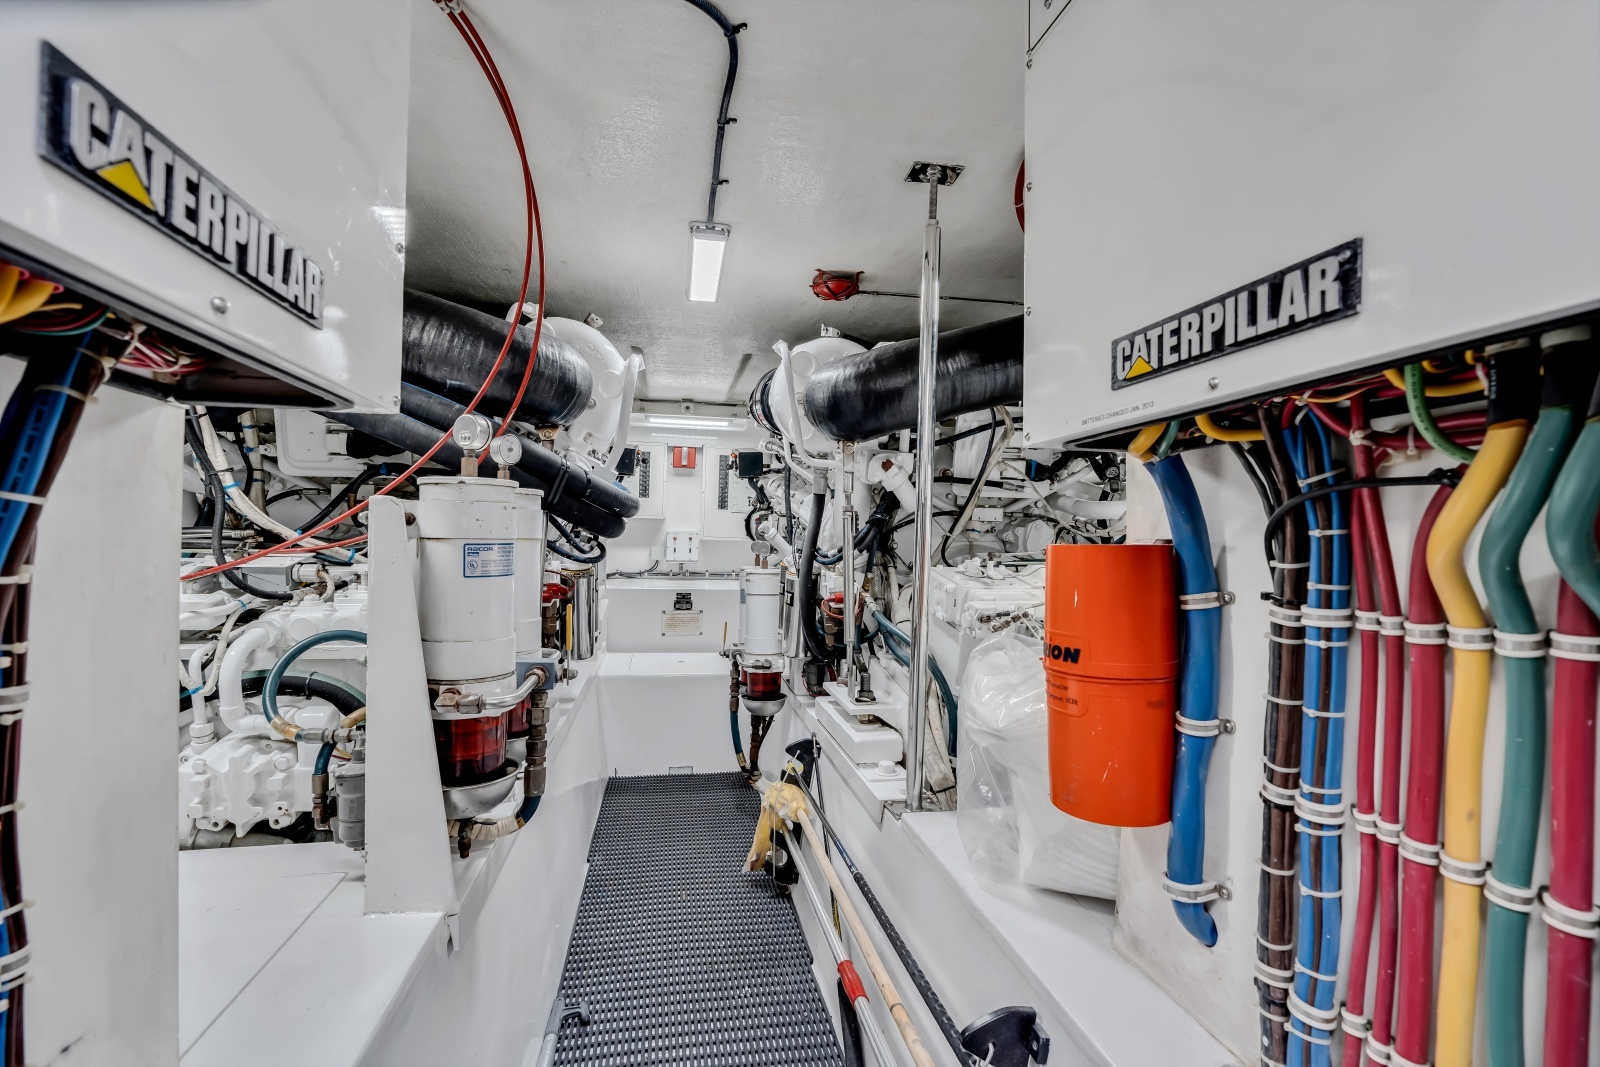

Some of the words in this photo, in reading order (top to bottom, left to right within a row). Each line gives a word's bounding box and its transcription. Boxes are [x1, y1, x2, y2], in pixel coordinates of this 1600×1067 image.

[70, 78, 321, 321] CATERPILLAR
[1116, 254, 1343, 381] CATERPILLAR
[1081, 414, 1105, 425] BATTERIES
[1106, 408, 1129, 419] CHANGED
[1142, 401, 1154, 410] 2013
